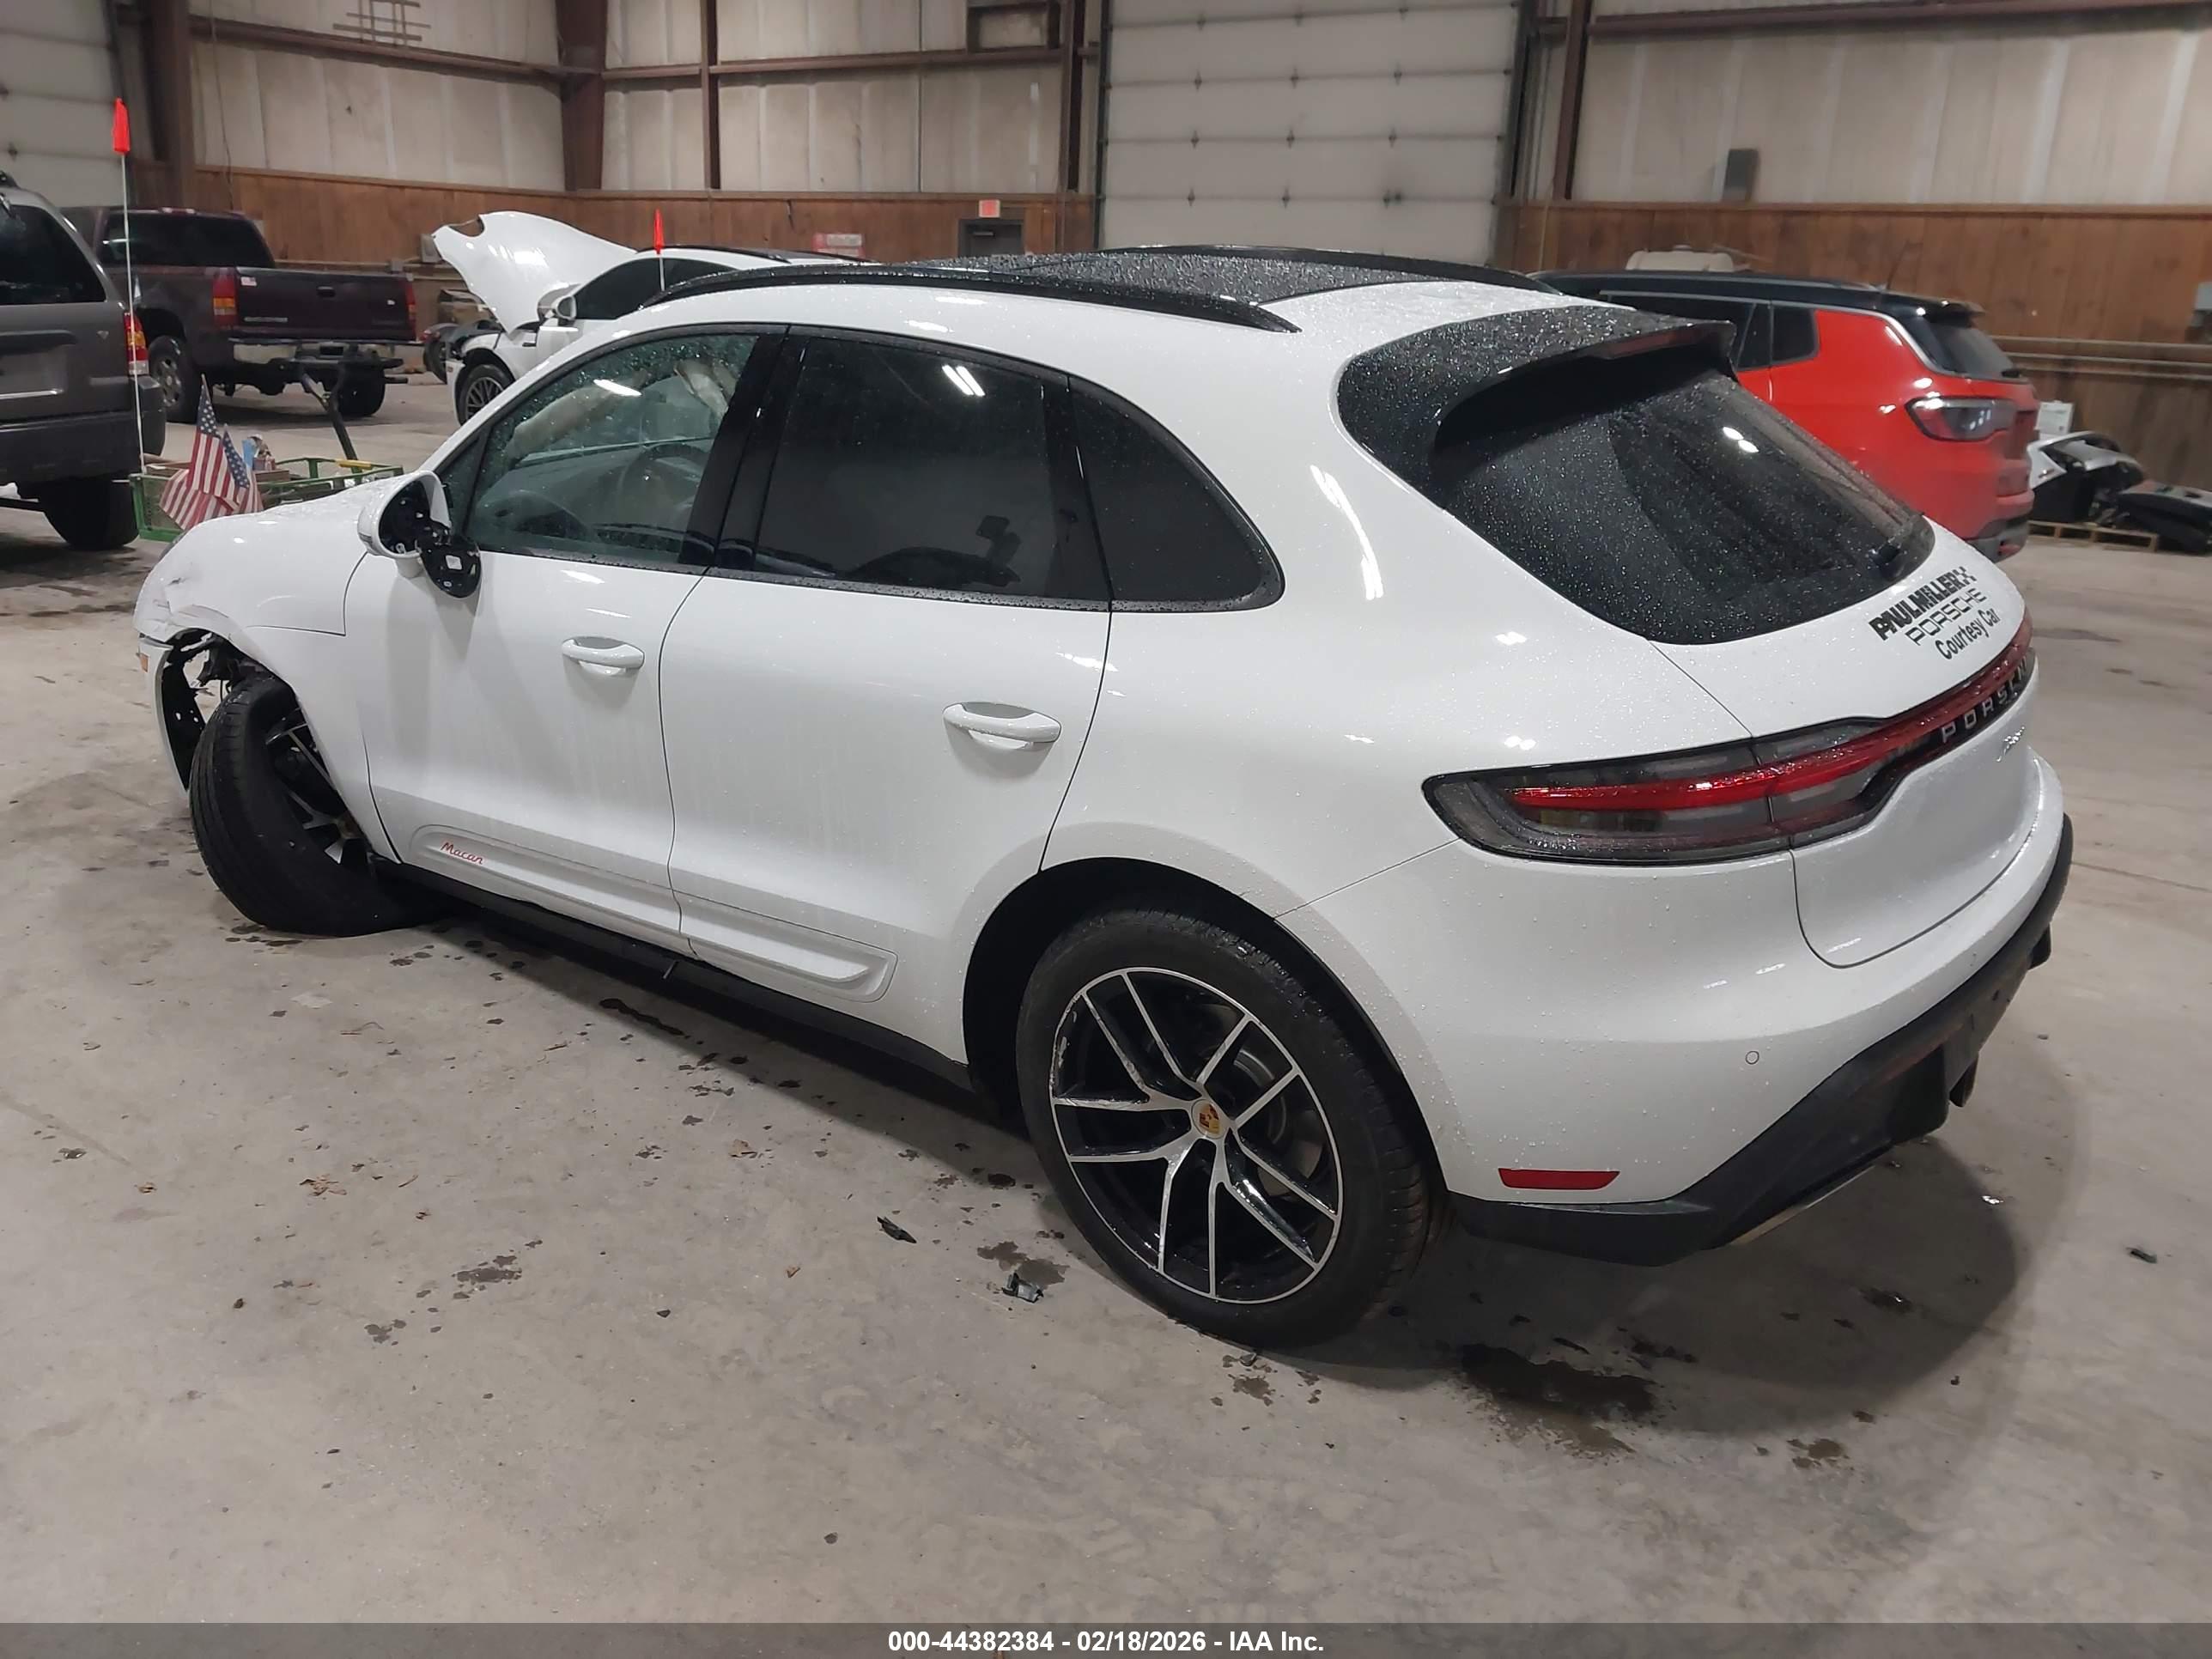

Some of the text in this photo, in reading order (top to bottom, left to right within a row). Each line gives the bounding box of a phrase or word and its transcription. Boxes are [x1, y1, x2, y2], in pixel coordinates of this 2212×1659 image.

[1905, 587, 1987, 646] PORSCHE
[1935, 607, 2002, 660] Courtesy Car
[1941, 655, 2027, 744] PORSC
[440, 842, 483, 865] Macan
